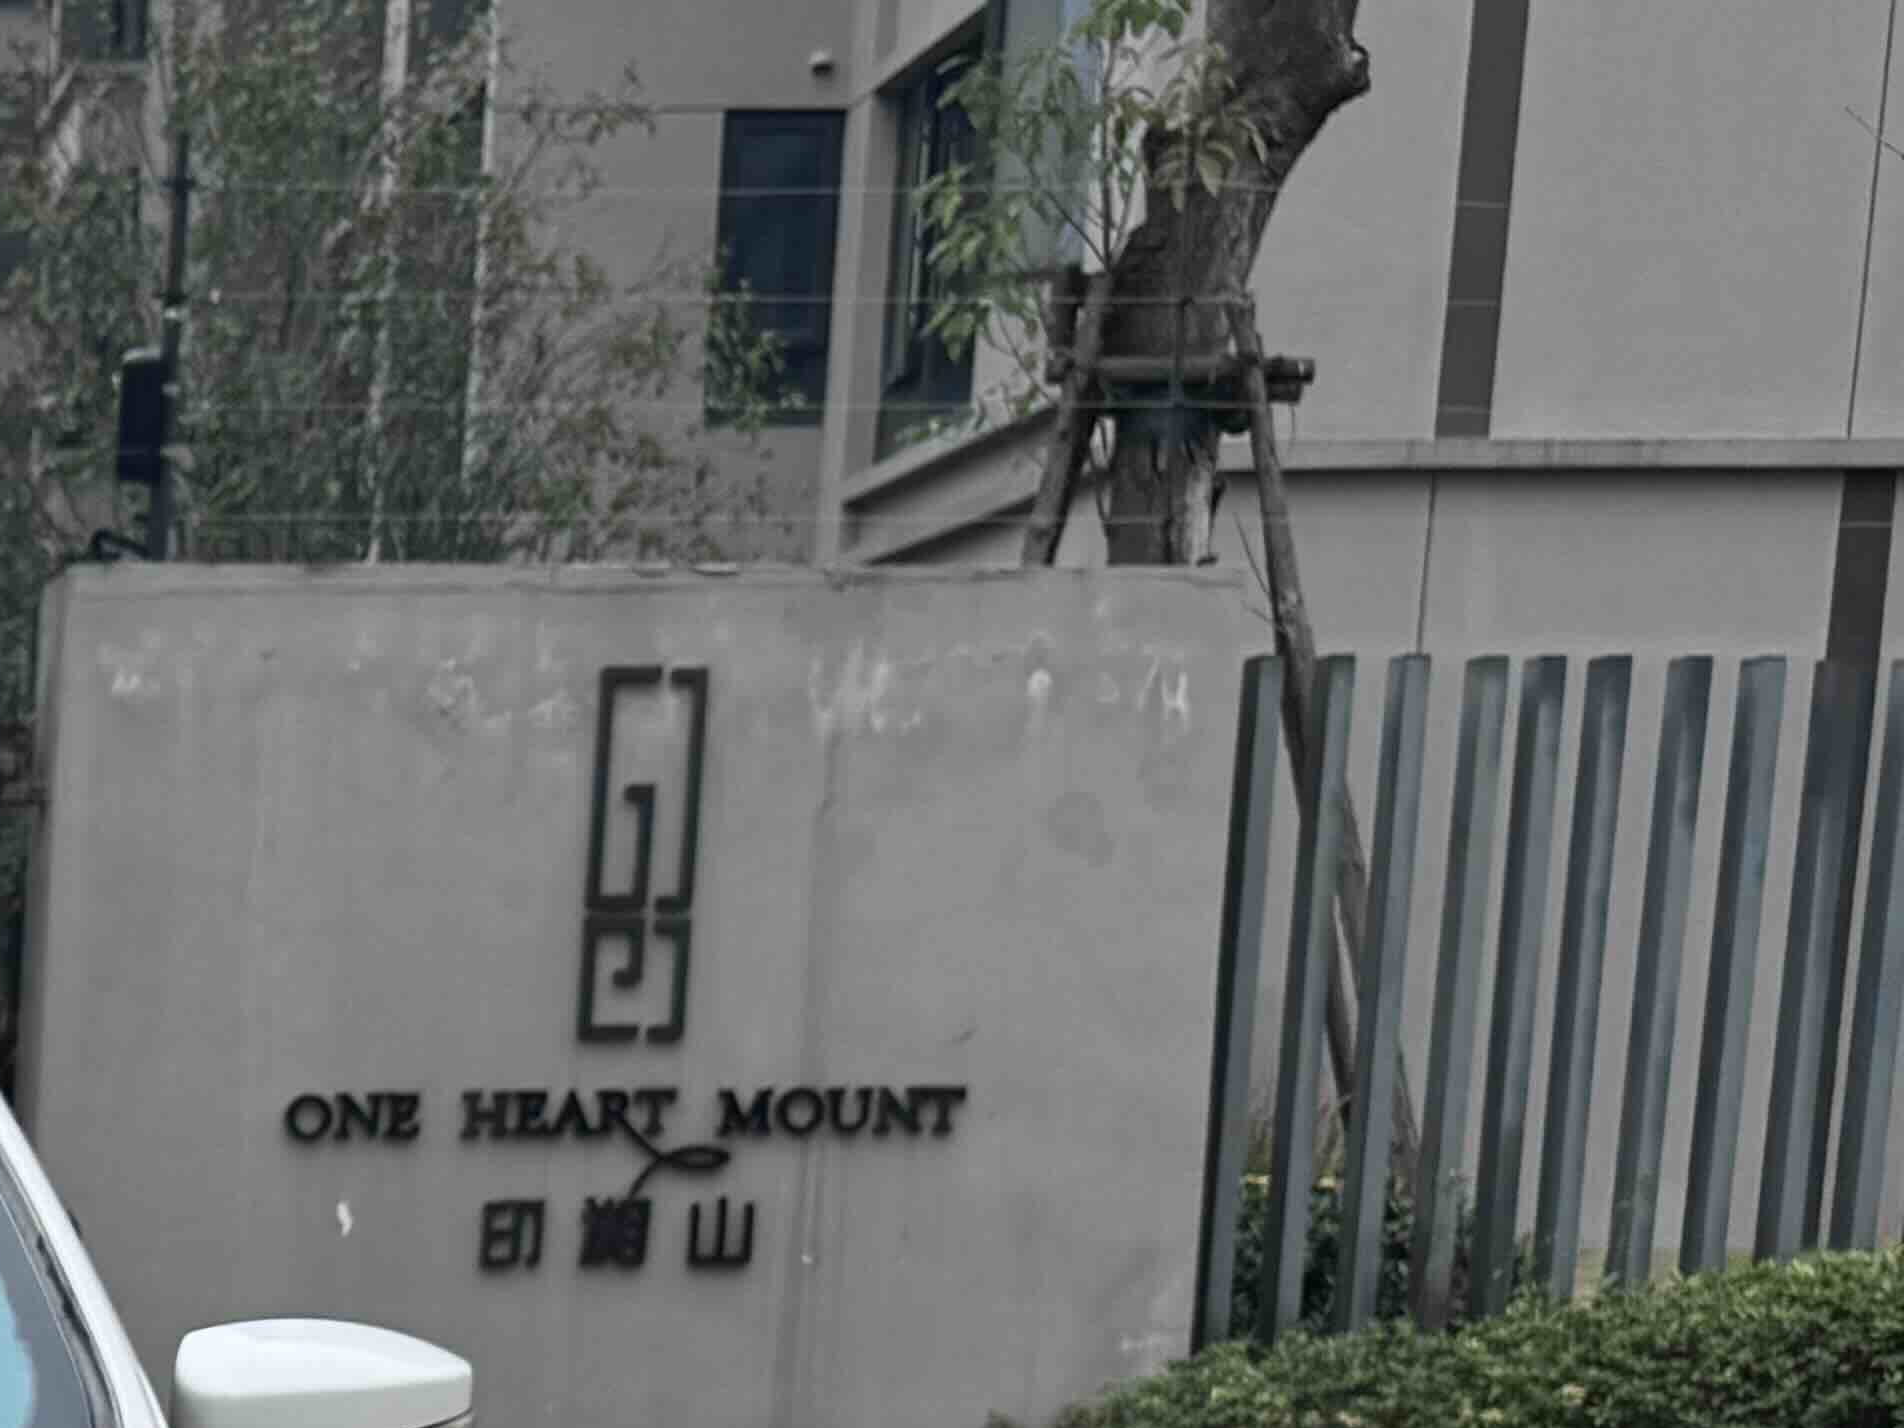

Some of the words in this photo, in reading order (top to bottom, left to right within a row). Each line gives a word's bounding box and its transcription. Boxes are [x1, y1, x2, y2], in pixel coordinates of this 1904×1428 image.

[283, 1090, 421, 1144] ONE
[458, 1086, 680, 1146] HEART
[714, 1085, 969, 1139] MOUNT
